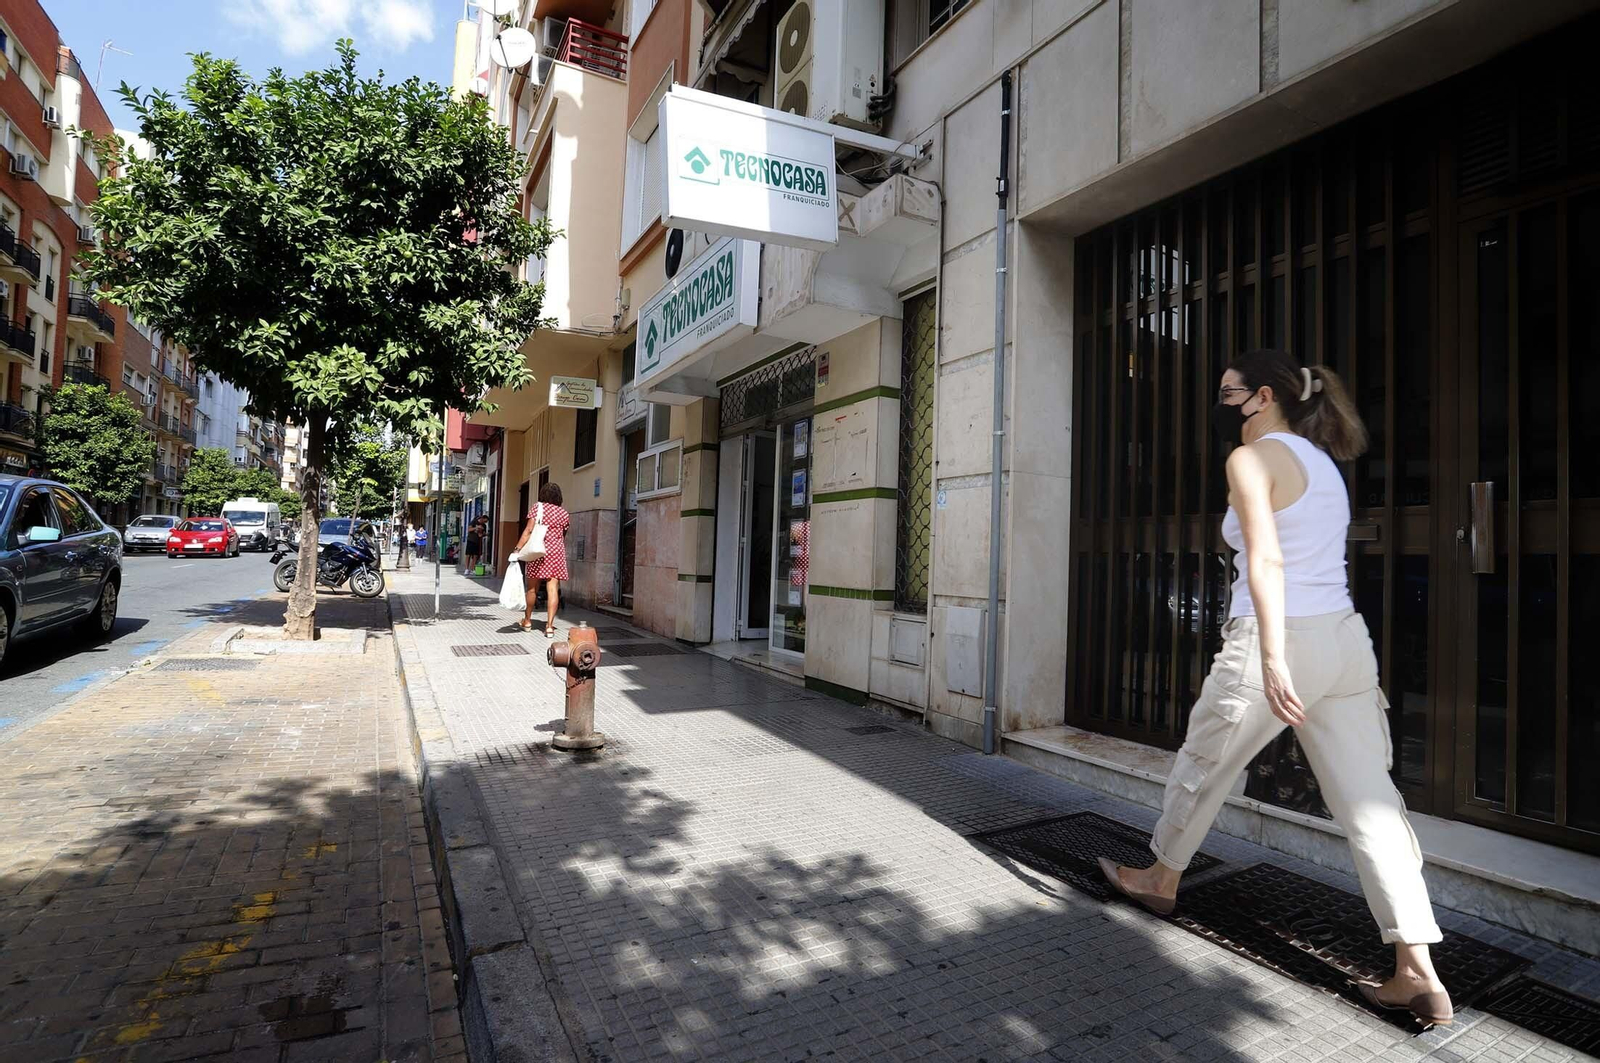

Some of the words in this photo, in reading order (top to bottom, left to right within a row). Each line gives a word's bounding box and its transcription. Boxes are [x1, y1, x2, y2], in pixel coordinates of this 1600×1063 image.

[720, 149, 826, 196] TECNOCASA
[783, 193, 830, 208] FRANQUICIADO
[662, 250, 734, 343] TECNOCASA
[696, 307, 735, 340] FRANQUICIADO
